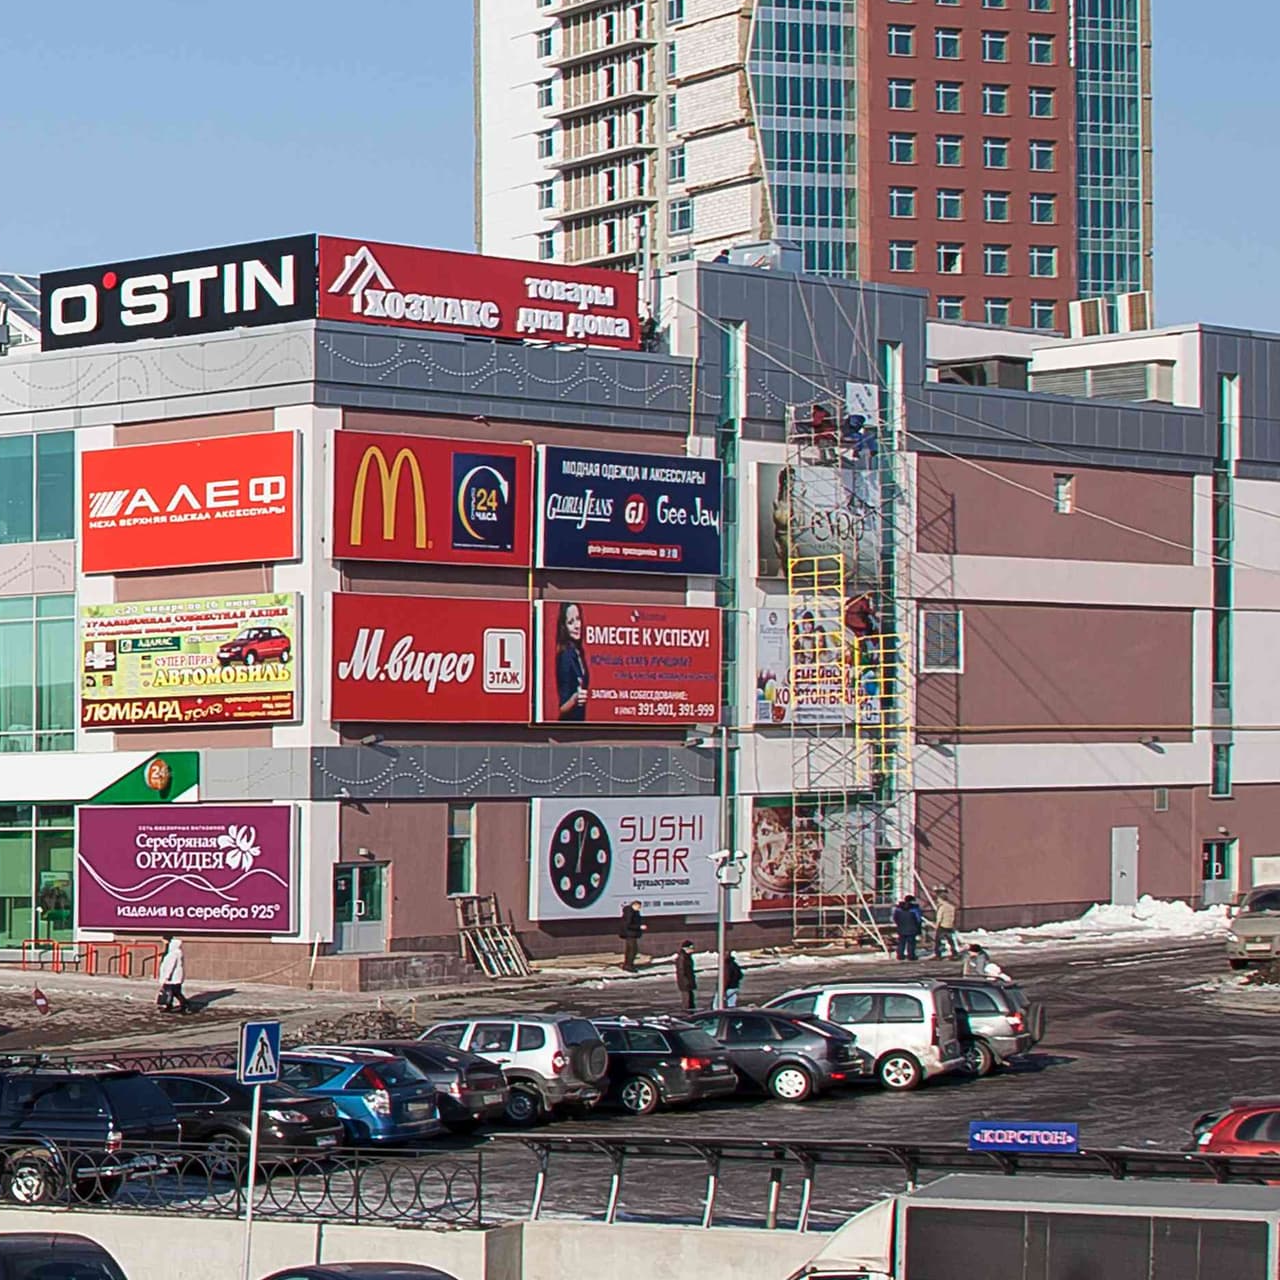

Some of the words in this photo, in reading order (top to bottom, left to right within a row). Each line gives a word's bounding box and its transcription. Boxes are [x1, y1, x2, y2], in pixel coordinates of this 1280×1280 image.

[524, 276, 614, 310] товары
[363, 288, 500, 329] ХОЗМАКС
[516, 307, 563, 333] для
[566, 314, 630, 339] дома
[562, 460, 600, 478] МОДНАЯ
[601, 463, 640, 482] ОДЕЖДА
[641, 468, 648, 480] И
[649, 467, 707, 485] АКСЕССУАРЫ
[124, 475, 286, 516] АЛЕФ
[476, 487, 499, 511] 24
[89, 519, 117, 529] МЕХА
[119, 515, 168, 527] ВЕРХНЯЯ
[169, 512, 211, 524] ОДЕЖДА
[215, 505, 286, 520] АКСЕССУАРЫ
[475, 511, 498, 521] ЧАСА
[657, 494, 687, 524] Gee
[691, 497, 720, 536] Jay
[586, 626, 640, 646] ВМЕСТЕ
[643, 628, 652, 645] К
[654, 628, 710, 648] УСПЕХУ!
[338, 627, 475, 694] М.видео
[153, 663, 291, 688] АВТОМОБИЛЬ
[488, 671, 520, 685] ЭТАЖ
[83, 699, 181, 724] ЛОМБАРД
[638, 703, 677, 718] 391-901,
[678, 703, 715, 717] 391-999
[151, 765, 169, 779] 24
[619, 815, 704, 843] SUSHI
[136, 833, 218, 852] Серебряная
[136, 851, 225, 872] ОРХИДЕЯ
[632, 847, 690, 875] BAR
[116, 904, 168, 917] изделия
[170, 905, 184, 917] из
[186, 903, 249, 920] серебра
[980, 1128, 1068, 1145] КОРСТОН
